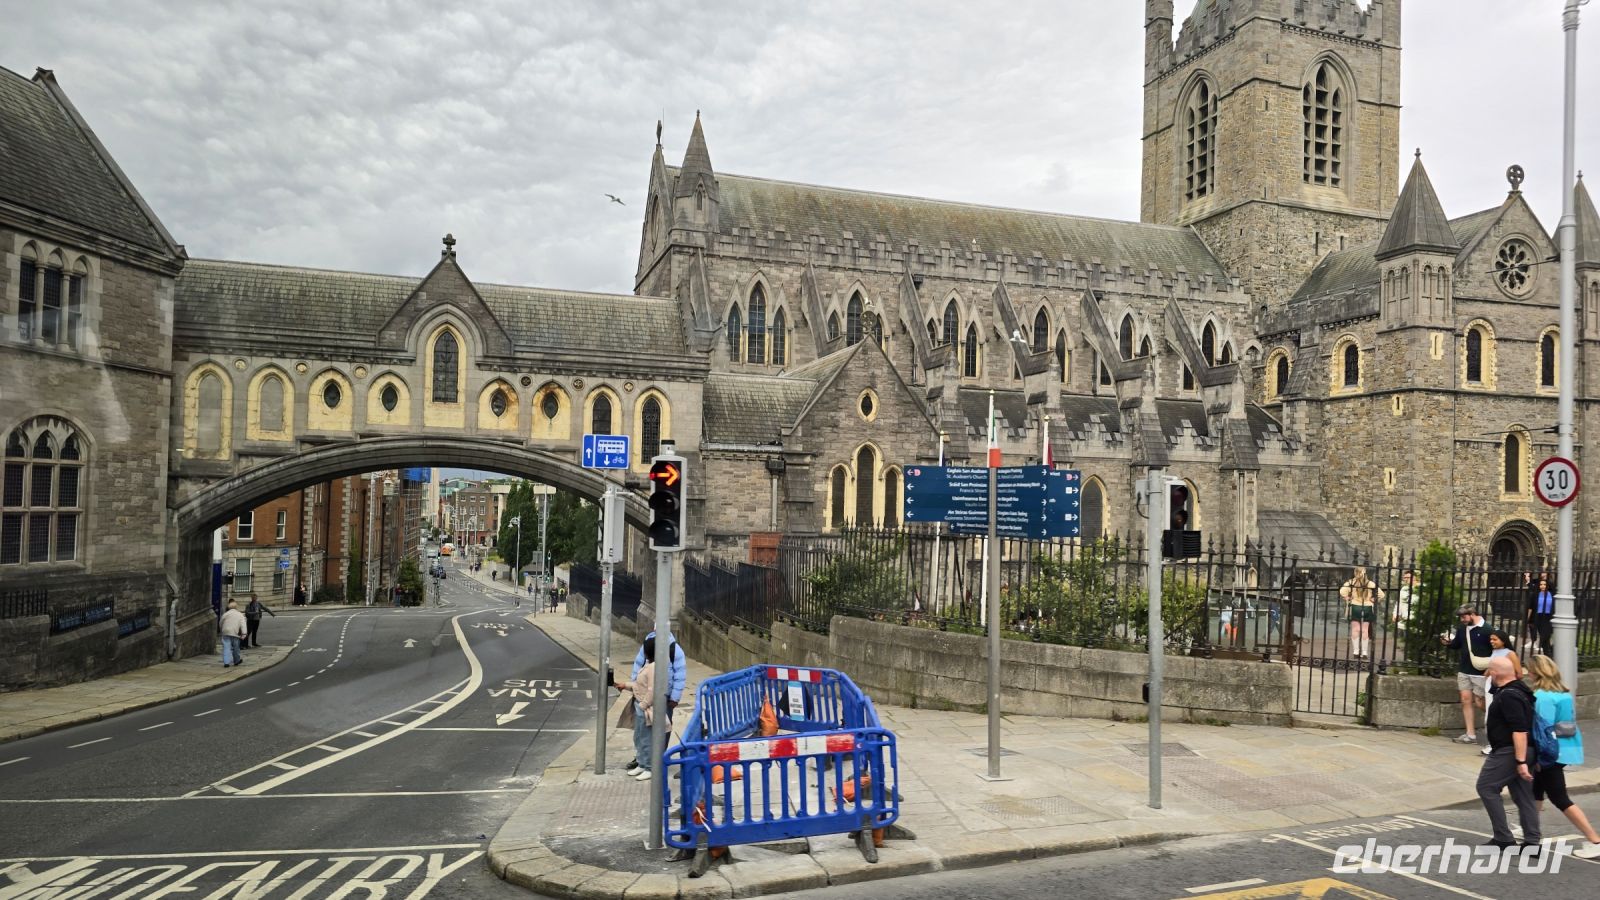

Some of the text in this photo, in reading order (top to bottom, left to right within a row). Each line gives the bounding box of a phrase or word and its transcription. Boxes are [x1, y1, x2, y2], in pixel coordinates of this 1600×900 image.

[1546, 469, 1568, 490] 30
[503, 679, 578, 688] BUS
[140, 850, 486, 900] ENTRY
